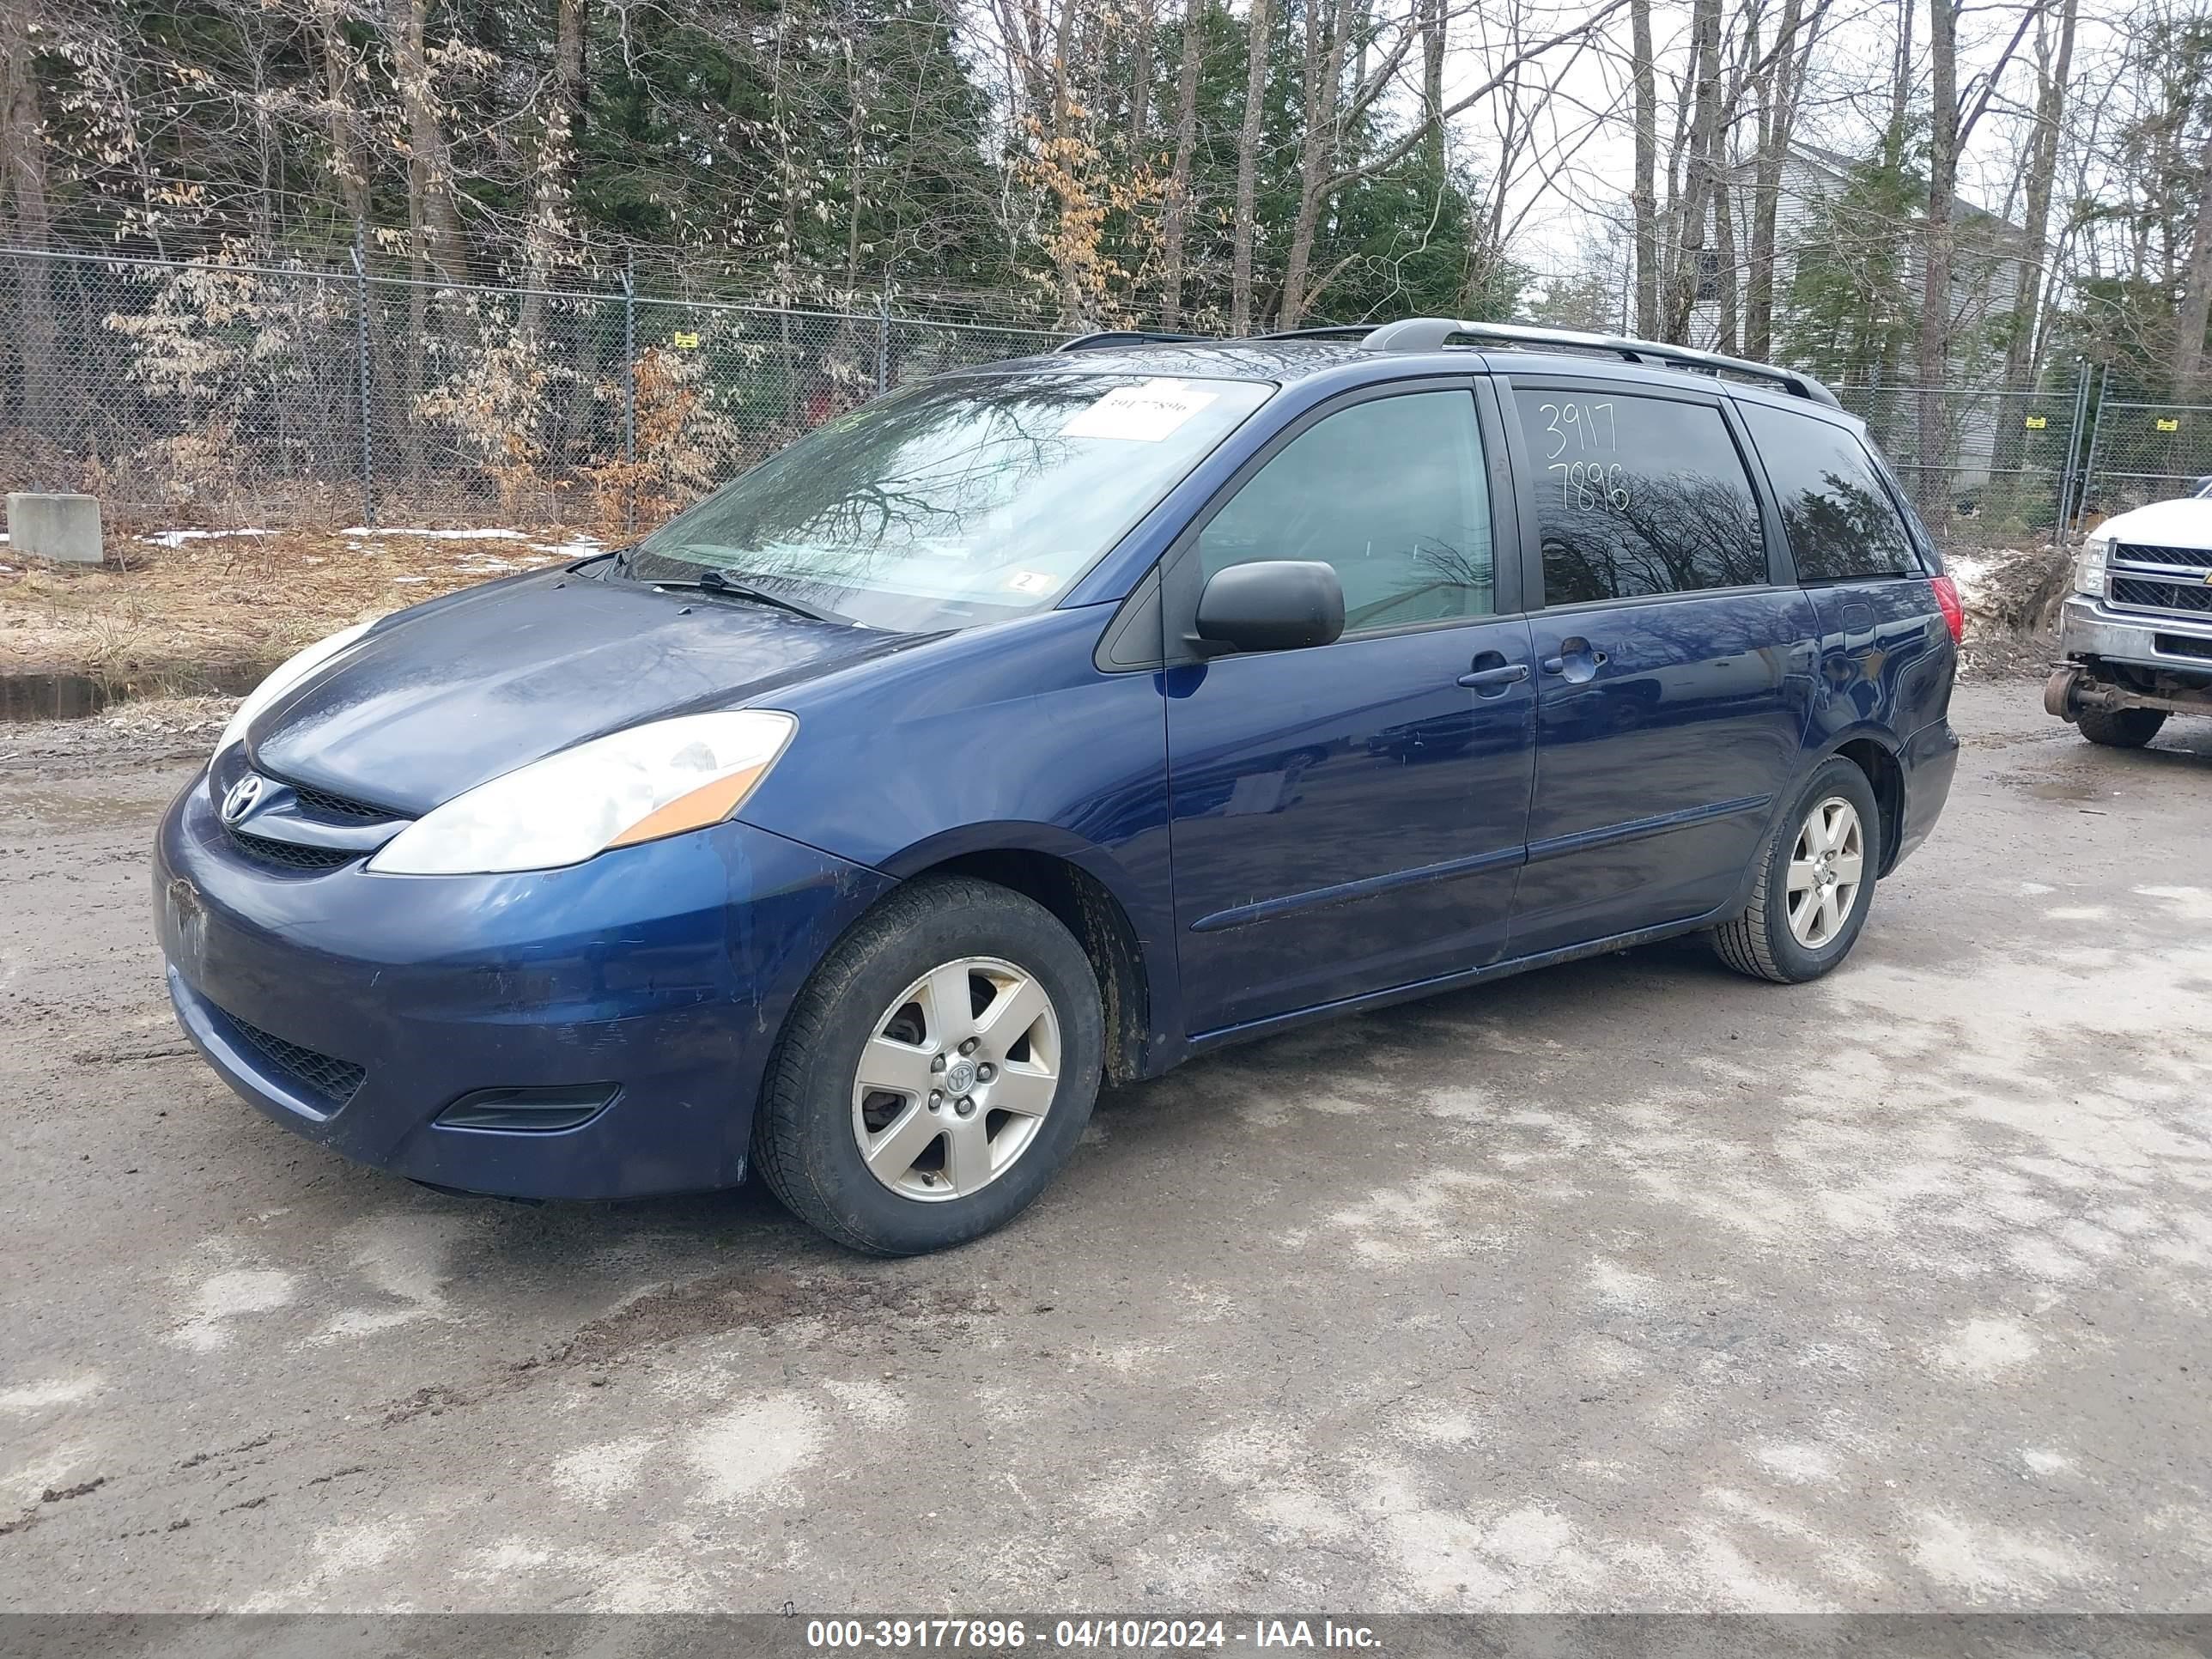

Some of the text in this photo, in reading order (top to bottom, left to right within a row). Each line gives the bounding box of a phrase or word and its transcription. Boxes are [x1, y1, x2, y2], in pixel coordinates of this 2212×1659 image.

[1539, 403, 1616, 459] 3917
[1548, 461, 1629, 512] 7896
[1016, 574, 1033, 586] 2
